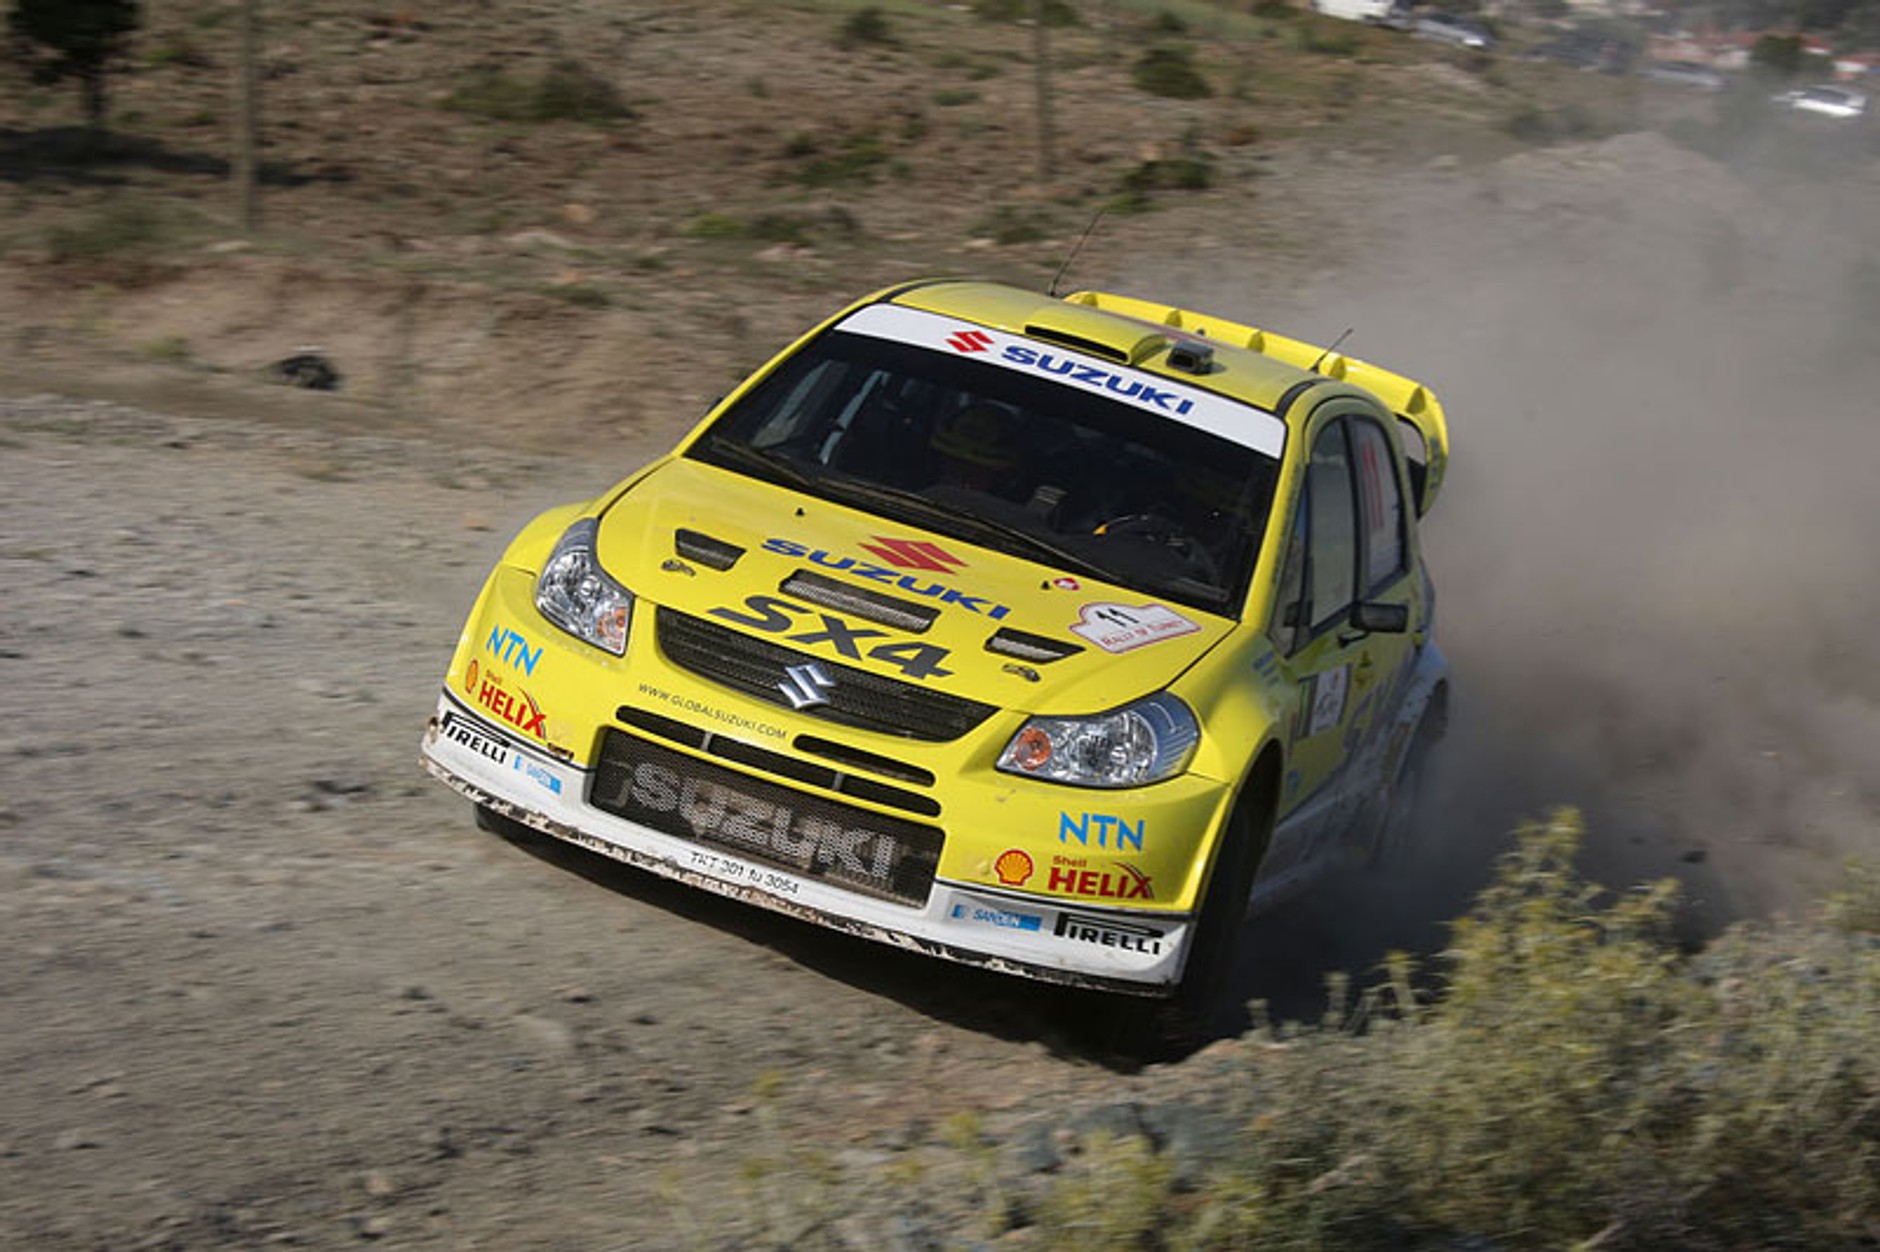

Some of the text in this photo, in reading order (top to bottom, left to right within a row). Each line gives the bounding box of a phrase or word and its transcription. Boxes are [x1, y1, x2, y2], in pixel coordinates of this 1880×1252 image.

[1002, 343, 1195, 416] SUZUKI
[761, 537, 1011, 620] SUZUKI
[707, 595, 955, 680] SX4
[1095, 607, 1139, 628] 11
[486, 624, 543, 677] NTN
[441, 710, 512, 765] PIRELLI
[478, 684, 547, 741] HELIX
[638, 682, 788, 740] WWW.GLOBALSUZUKI.COM
[632, 762, 898, 880] SUZUKI
[1058, 811, 1145, 852] NTN
[1048, 863, 1156, 900] HELIX
[1052, 855, 1088, 868] Shell
[1053, 911, 1165, 956] PIRELLI
